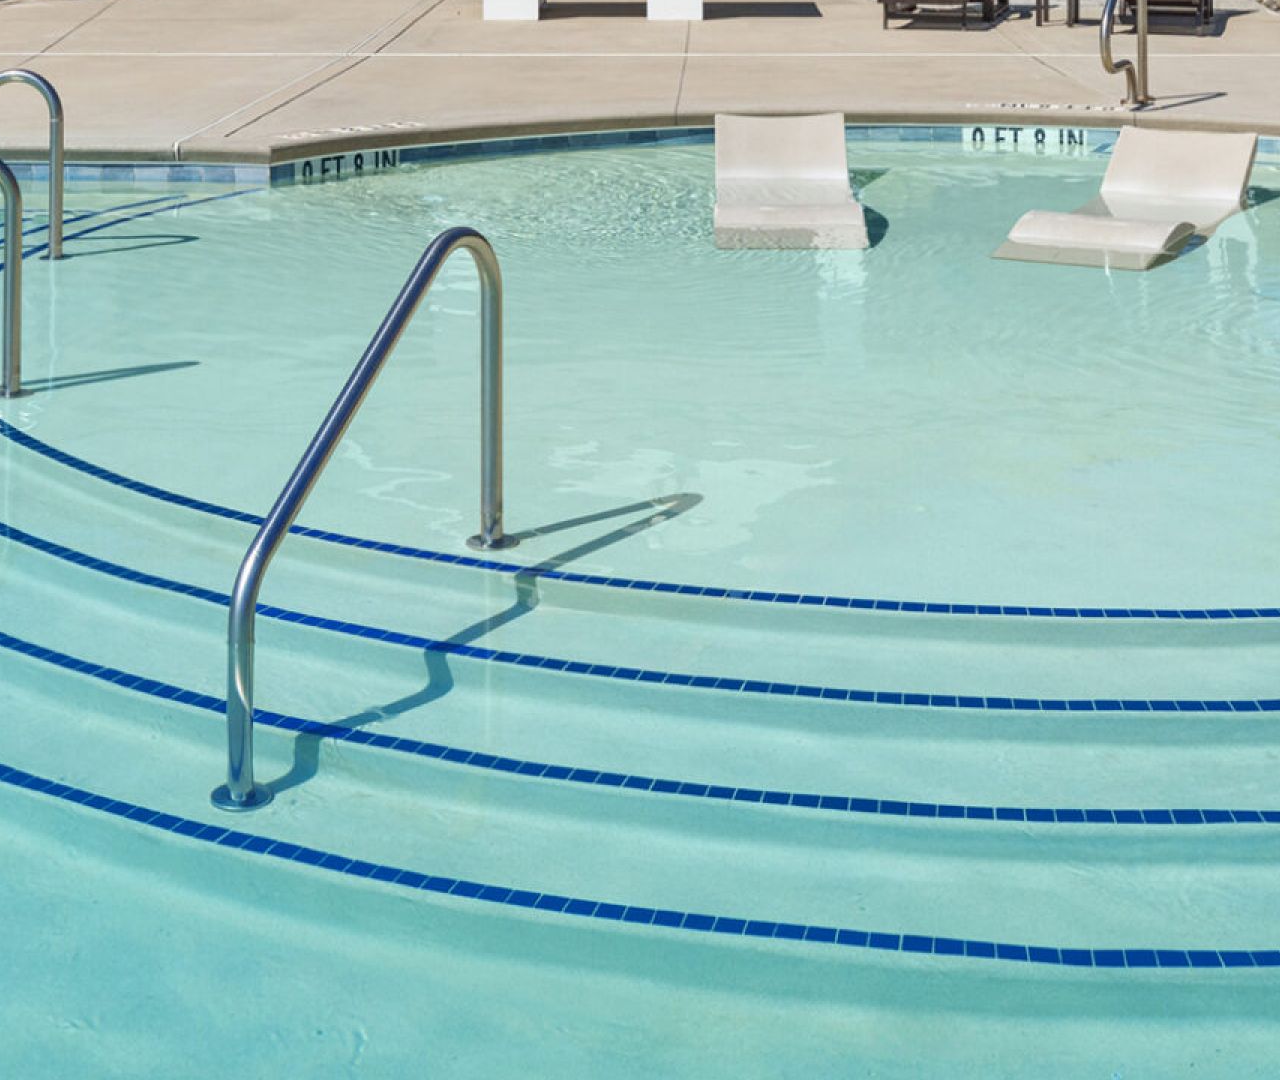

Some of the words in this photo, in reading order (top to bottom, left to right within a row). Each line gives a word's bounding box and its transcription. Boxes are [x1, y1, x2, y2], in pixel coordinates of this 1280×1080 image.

[995, 127, 1023, 146] FT
[1059, 128, 1084, 147] IN
[321, 155, 345, 179] FT
[374, 149, 397, 170] IN
